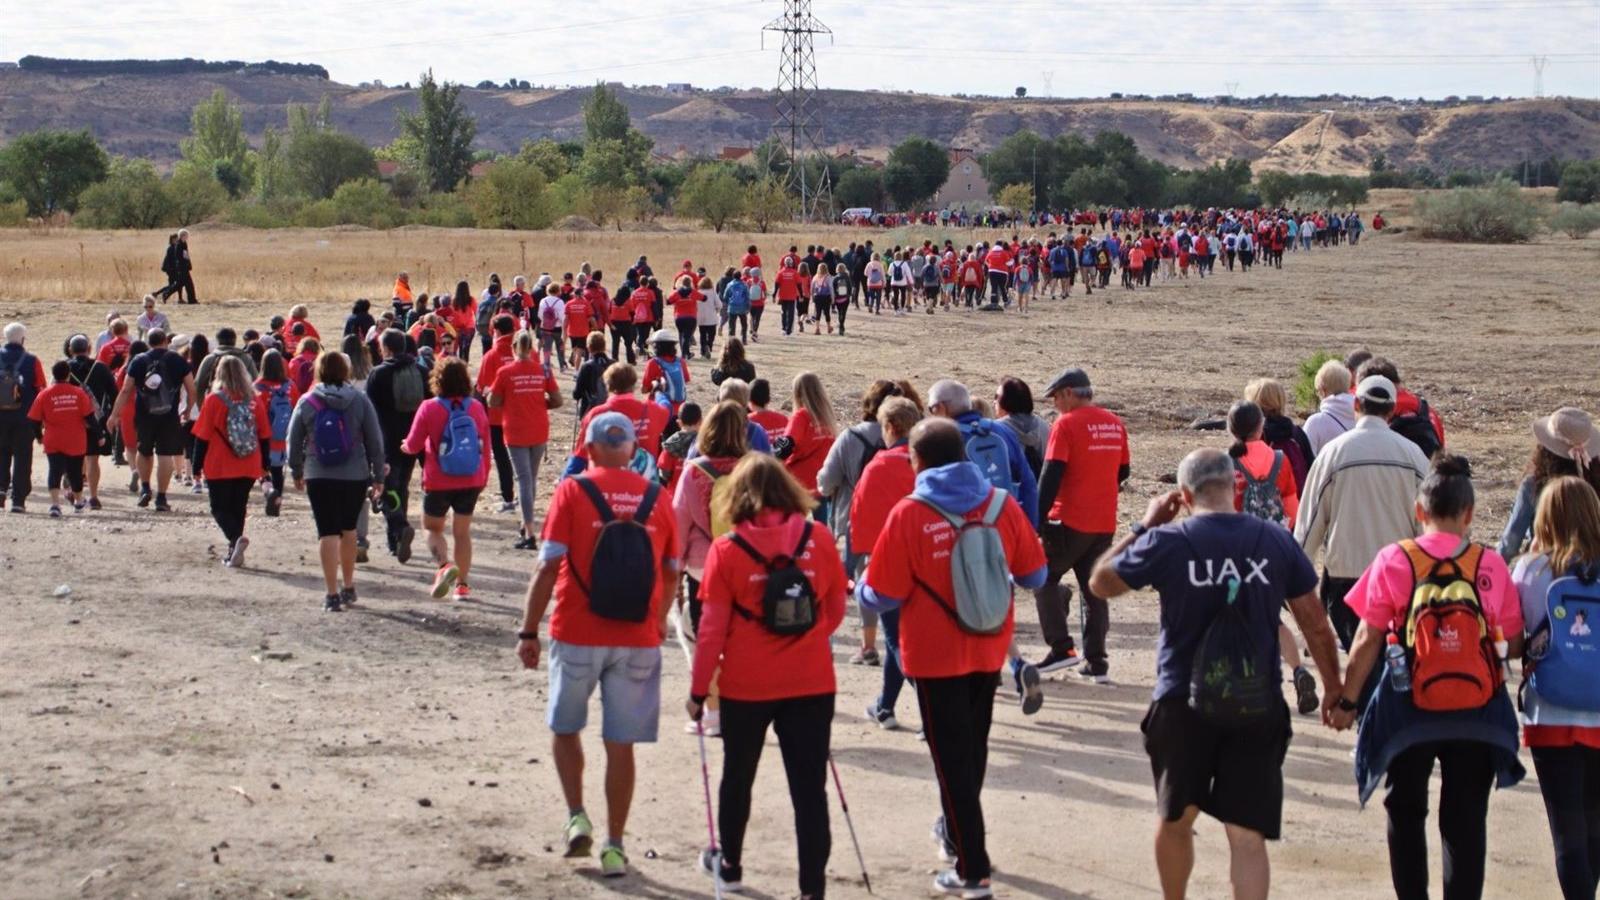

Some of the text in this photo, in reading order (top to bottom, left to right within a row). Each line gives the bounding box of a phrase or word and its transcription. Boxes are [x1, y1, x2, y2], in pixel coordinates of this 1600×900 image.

[1098, 422, 1116, 431] salud
[612, 504, 638, 512] cam
[933, 532, 949, 543] por
[1188, 557, 1270, 587] UAX
